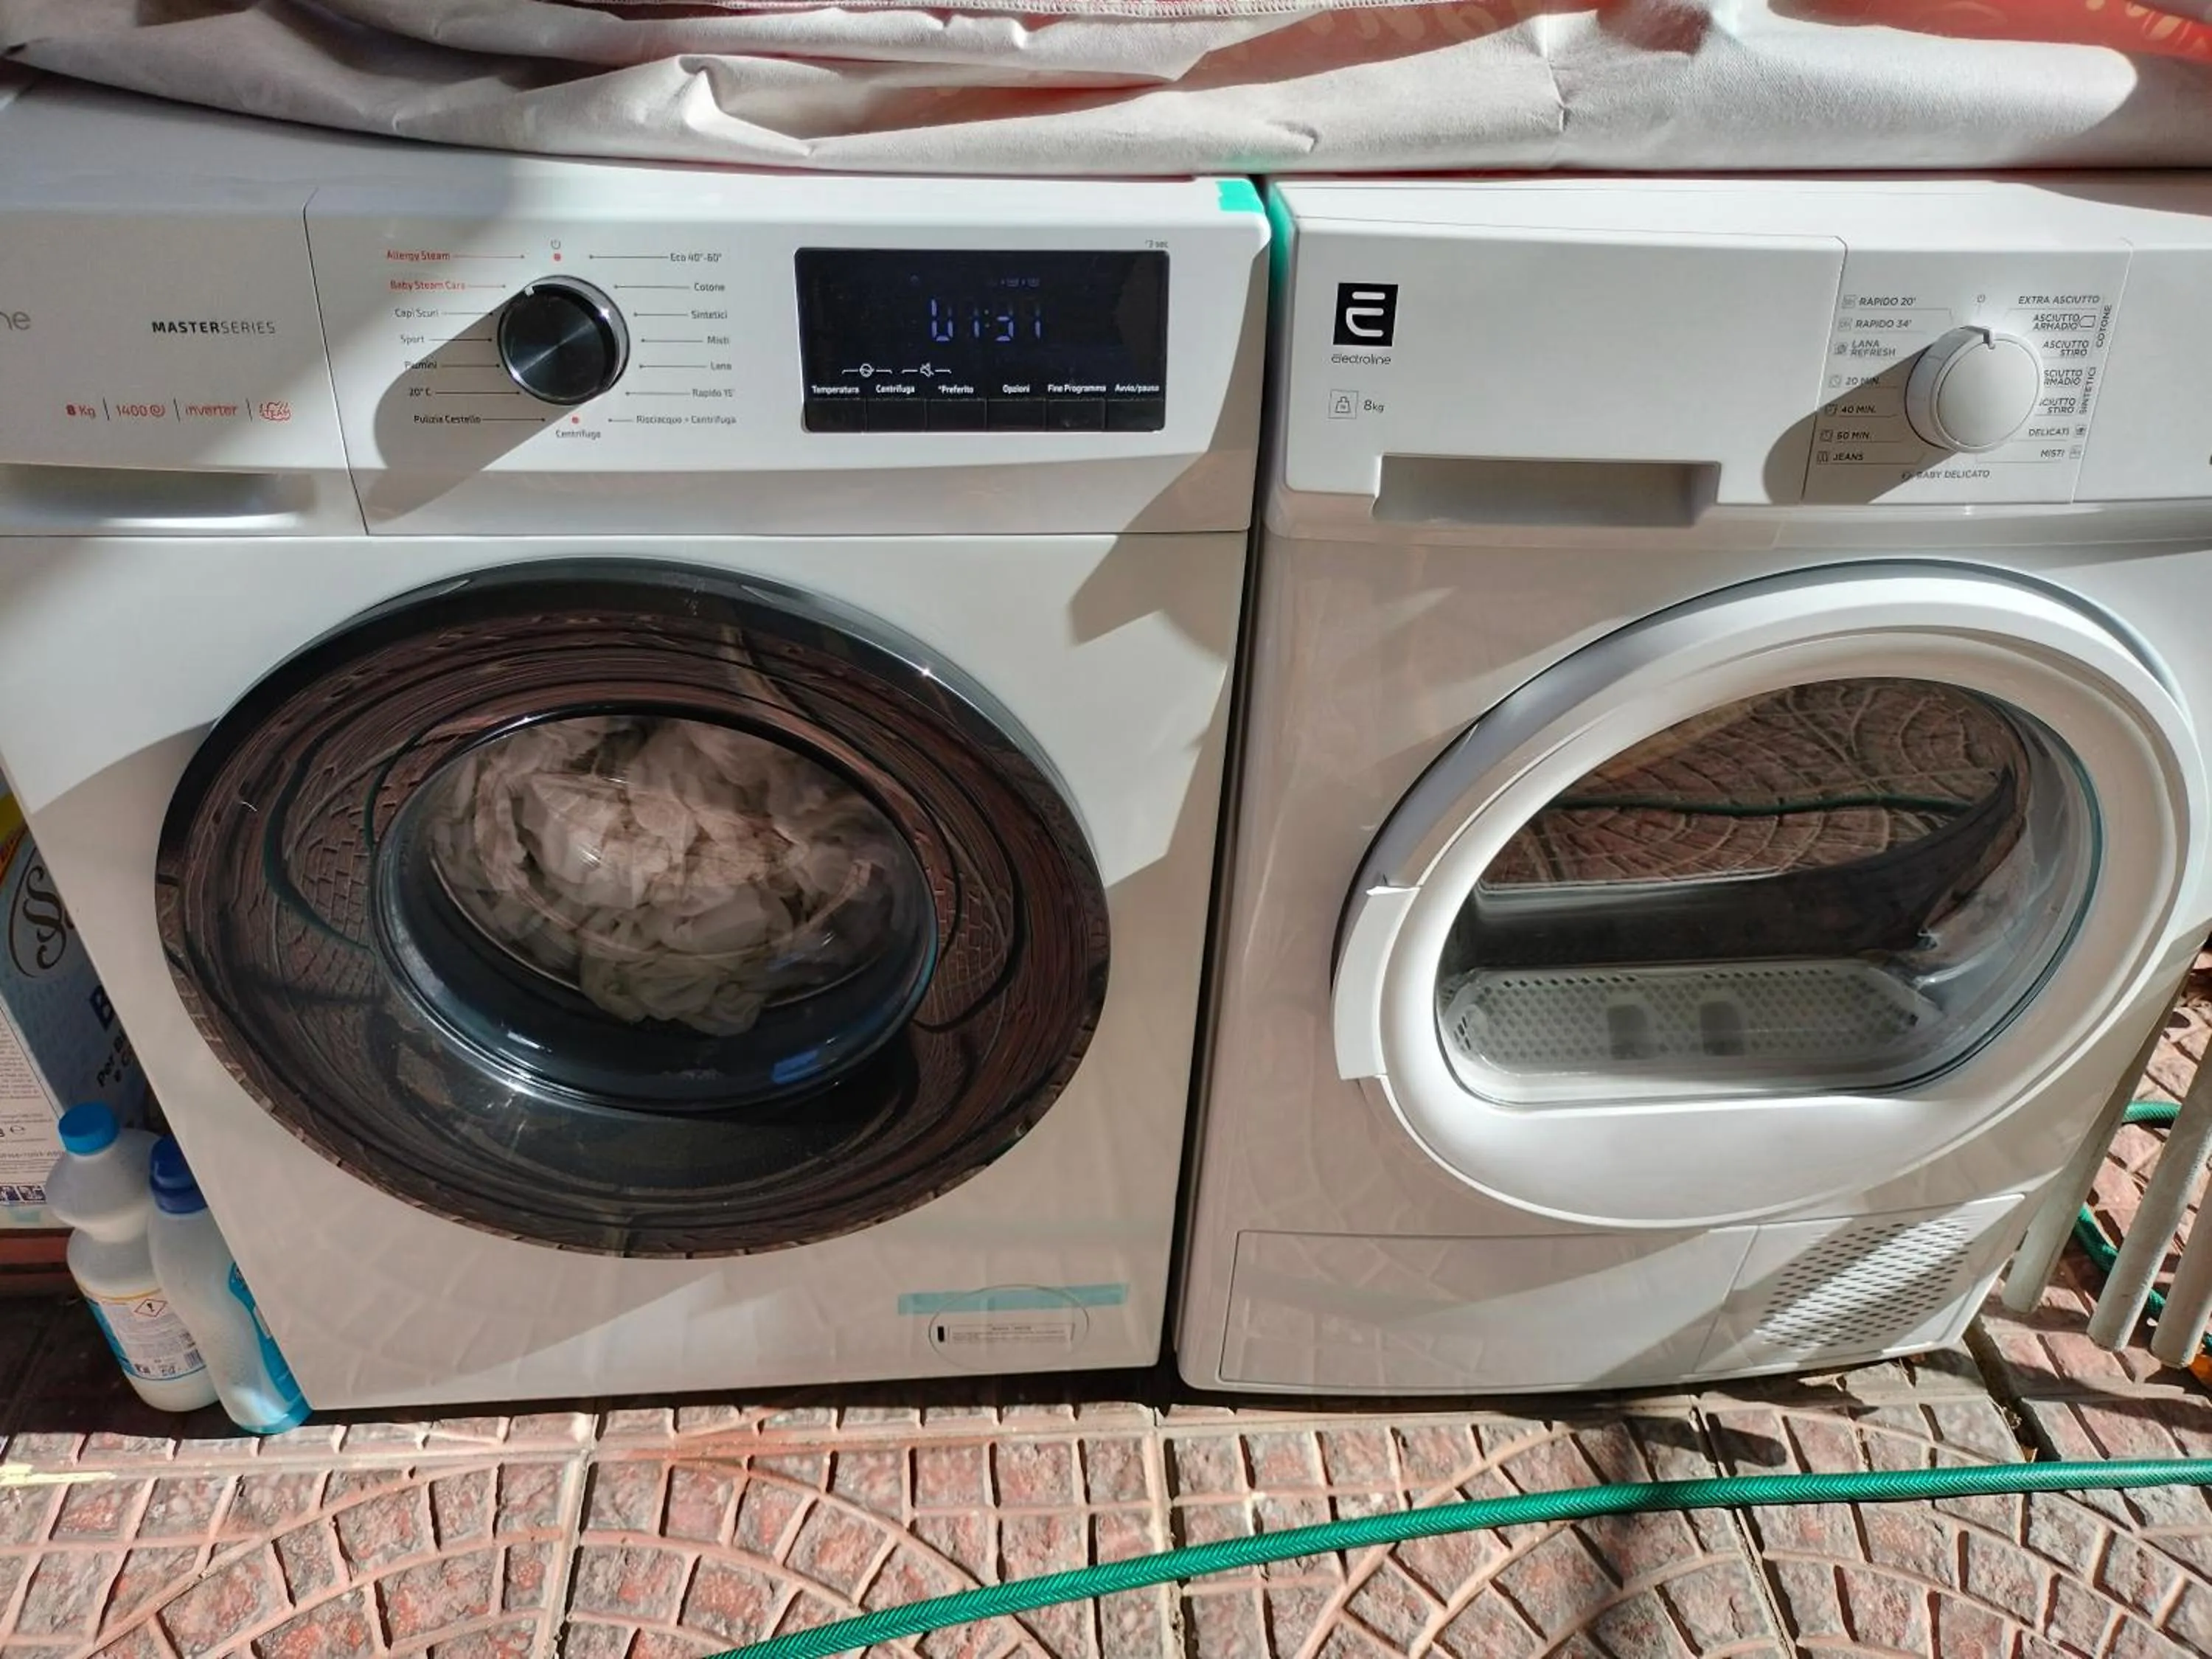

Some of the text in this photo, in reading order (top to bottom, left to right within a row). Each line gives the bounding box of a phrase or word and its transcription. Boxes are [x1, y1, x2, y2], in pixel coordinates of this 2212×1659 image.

[386, 251, 451, 261] Allergy Steam
[670, 253, 686, 262] Eco
[390, 280, 412, 291] Baby
[445, 281, 465, 290] Care
[694, 282, 726, 291] Cotone
[1859, 296, 1916, 306] RAPIDO 20'
[2018, 295, 2100, 305] EXTRA ASCIUTTO
[394, 308, 439, 319] Capi Scuri
[691, 310, 728, 319] Sintetici
[2033, 313, 2080, 322] ASCIUTTO
[152, 321, 276, 335] MASTERSERIES
[1855, 319, 1912, 328] RAPIDO 34'
[2033, 322, 2079, 330] ARMADIO
[2096, 305, 2112, 348] COTONE
[400, 335, 425, 346] Sport
[707, 335, 729, 344] Misti
[1851, 339, 1880, 349] LANA
[2042, 340, 2090, 349] ASCIUTTO
[1850, 348, 1896, 357] REFRESH
[2059, 349, 2088, 357] STIRO
[711, 362, 733, 371] Lana
[2043, 369, 2083, 378] SCIUTTO
[1846, 377, 1860, 386] 20
[2043, 377, 2081, 386] RMADIO
[425, 388, 432, 396] C
[811, 385, 860, 394] Temperatura
[876, 384, 915, 394] Centrifuga
[1003, 384, 1031, 394] Opzioni
[1048, 384, 1107, 394] Fine Programma
[1114, 384, 1160, 393] Avvio/pausa
[2079, 366, 2096, 414] SINTETICI
[692, 389, 723, 399] Rapido
[2041, 398, 2076, 406] CIUTTO
[66, 405, 96, 418] 8 Kg
[116, 405, 147, 417] 1400
[185, 406, 238, 417] inverter
[1856, 406, 1877, 414] MIN.
[414, 415, 481, 424] Pulizia Cestello
[636, 415, 682, 425] Risciacquo
[690, 415, 737, 425] Centrifuga
[555, 429, 601, 440] Centrifuga
[2028, 428, 2070, 437] DELICATI
[1833, 453, 1864, 462] JEANS
[2040, 449, 2065, 458] MISTI
[1917, 470, 1990, 479] BABY DELICATO
